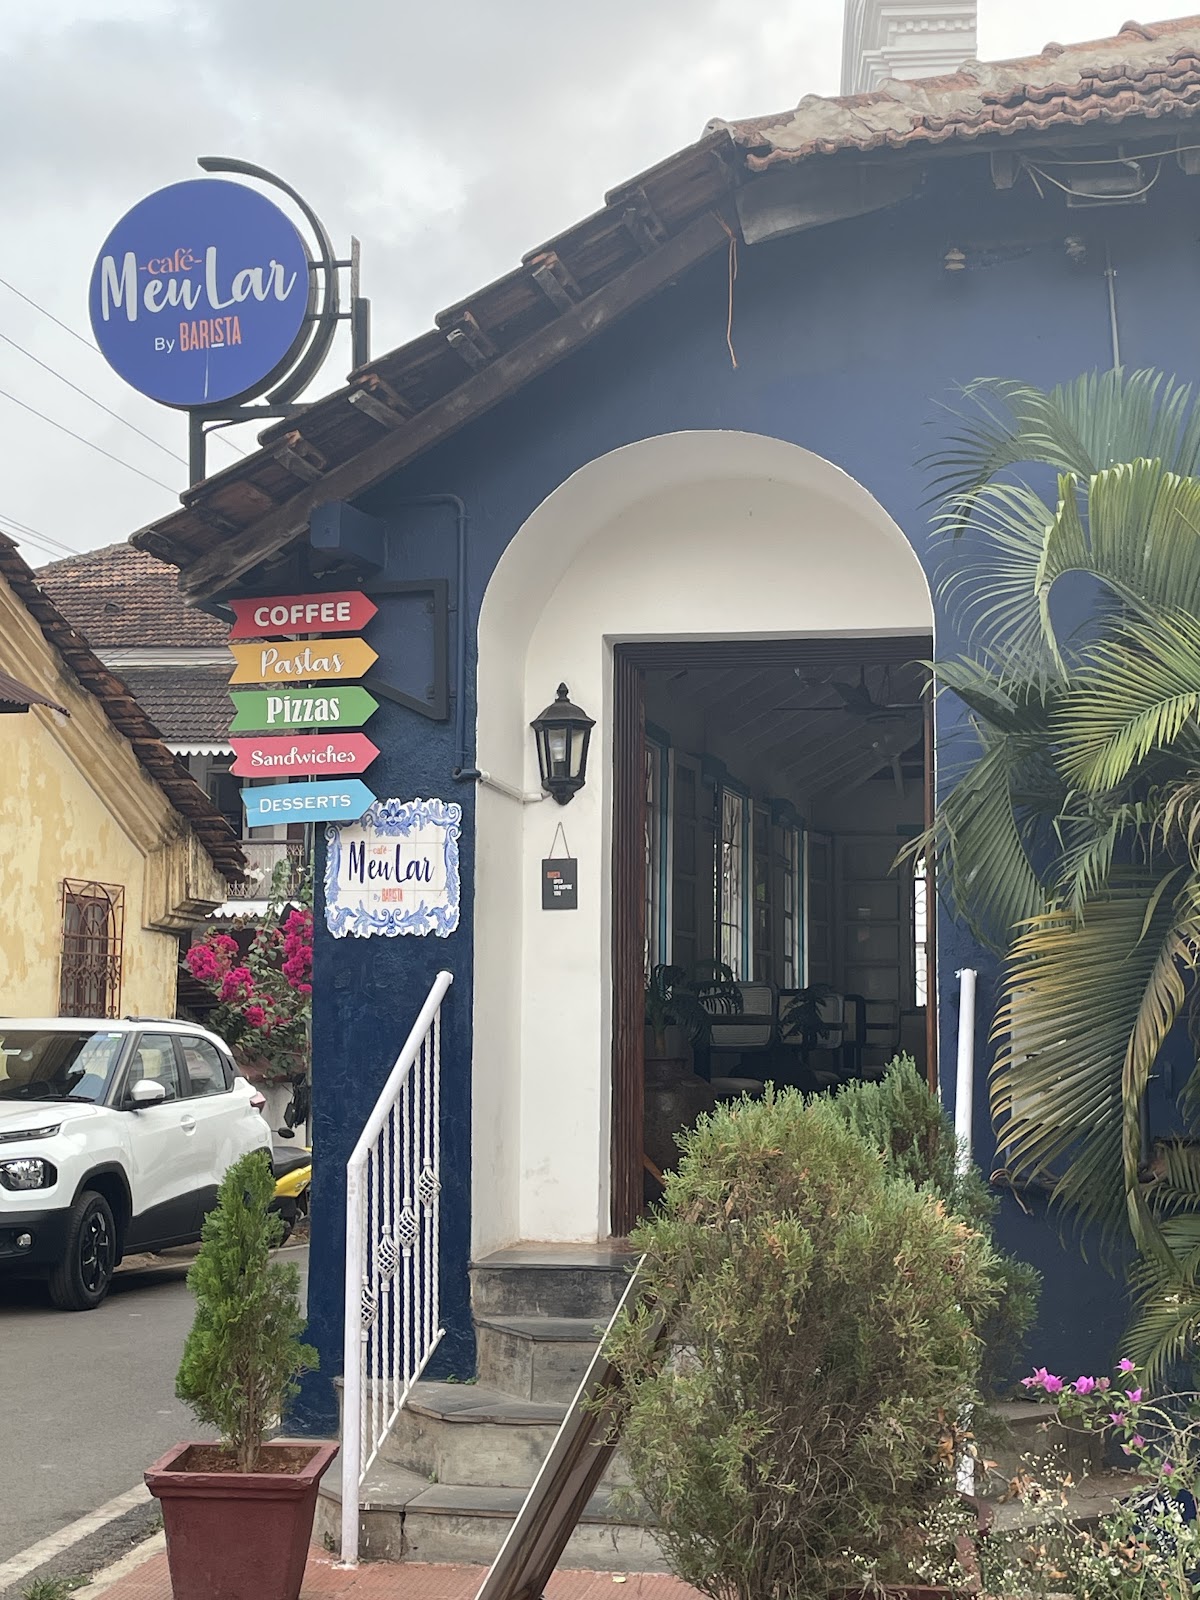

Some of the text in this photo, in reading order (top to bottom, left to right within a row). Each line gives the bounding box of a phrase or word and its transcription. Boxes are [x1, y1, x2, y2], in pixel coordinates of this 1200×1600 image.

[102, 246, 297, 322] Meu Lar
[154, 316, 242, 354] By BARISTA
[254, 602, 351, 627] COFFEE
[261, 647, 345, 677] Pastas
[266, 695, 340, 723] Pizzas
[251, 745, 356, 767] Sandwiches
[260, 794, 351, 813] DESSERTS
[348, 840, 436, 884] Meu Lar
